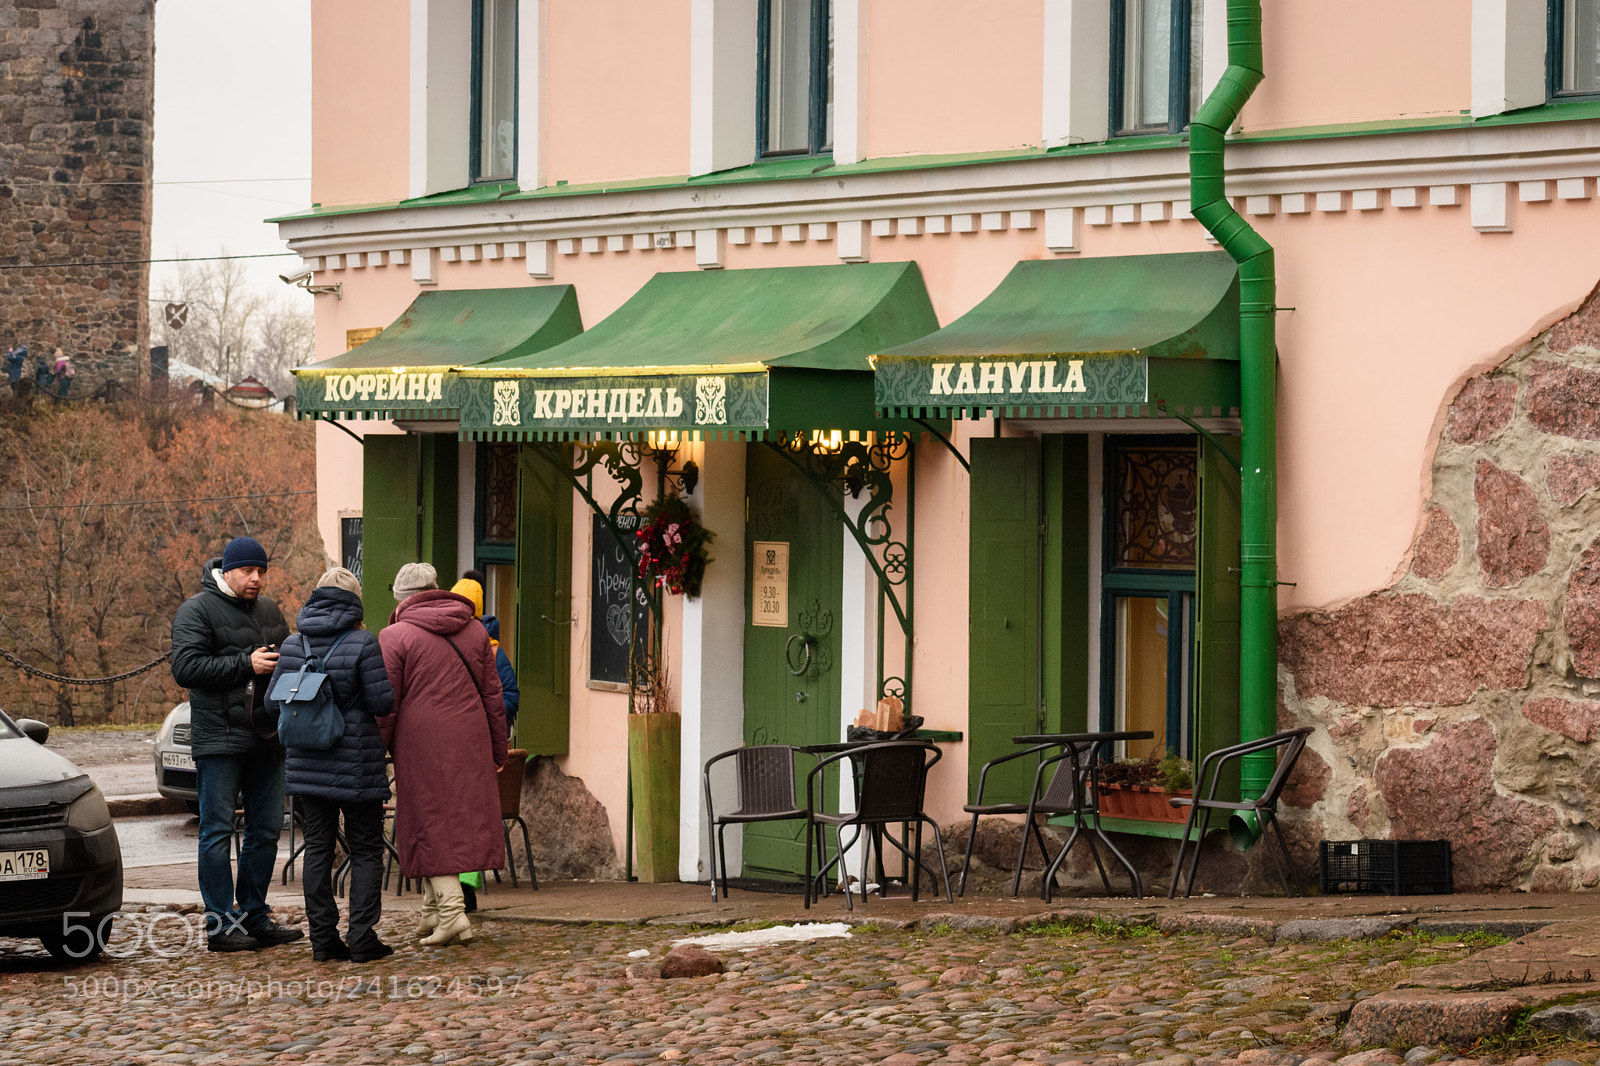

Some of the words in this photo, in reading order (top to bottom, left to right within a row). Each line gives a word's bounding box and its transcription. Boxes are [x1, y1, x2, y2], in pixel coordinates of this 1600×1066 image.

[324, 368, 443, 403] КОФЕЙНЯ
[930, 360, 1087, 395] KAHVILA
[533, 388, 683, 423] КРЕНДЕЛЬ
[763, 601, 780, 613] 20.30
[17, 852, 45, 867] 178
